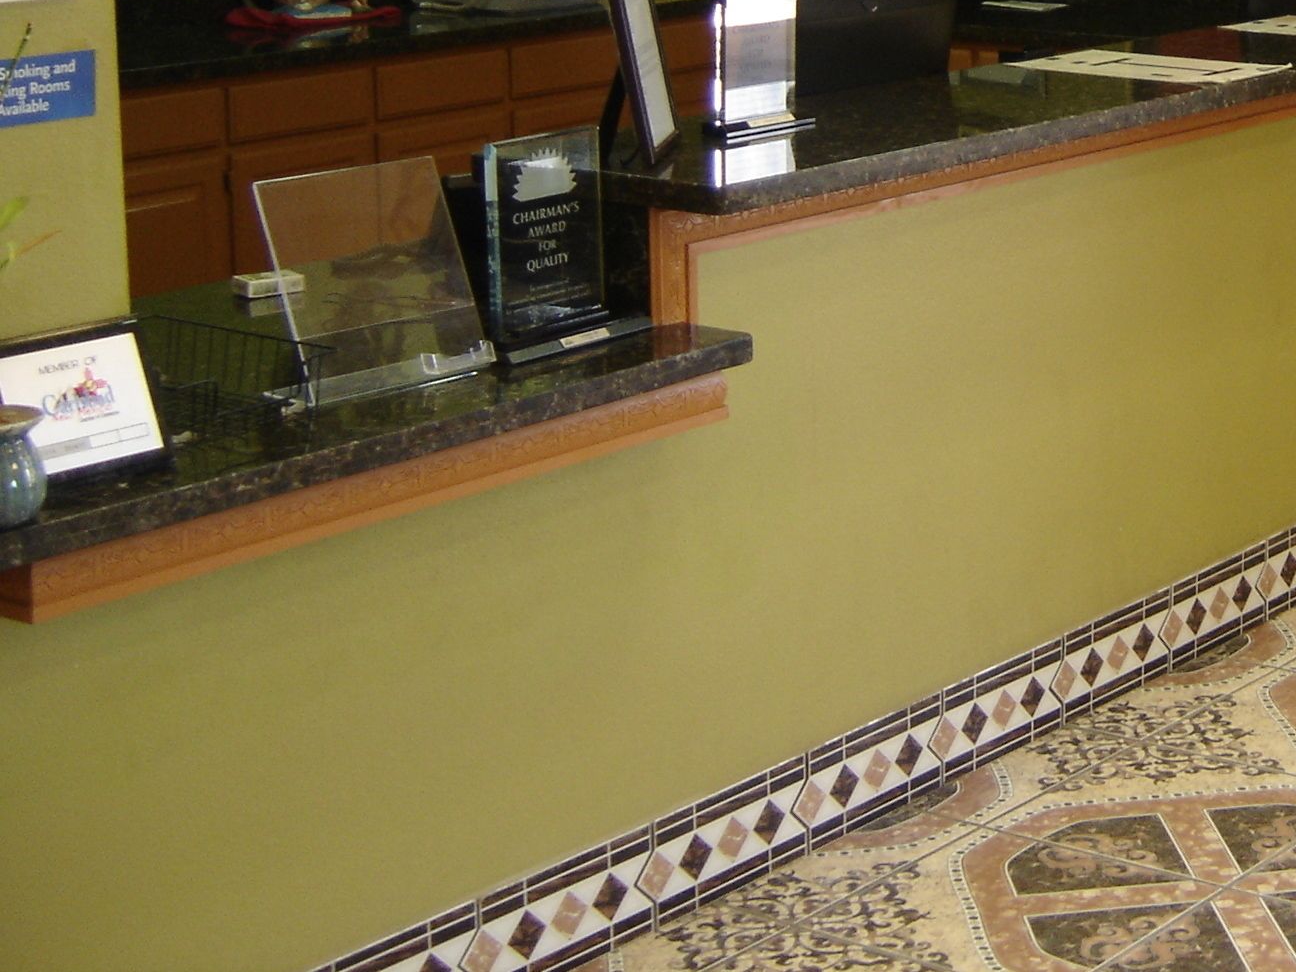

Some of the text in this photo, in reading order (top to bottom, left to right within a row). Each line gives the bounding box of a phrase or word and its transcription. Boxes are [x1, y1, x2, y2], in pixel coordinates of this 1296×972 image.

[53, 59, 76, 73] and
[30, 81, 70, 94] Rooms
[0, 98, 50, 116] Available
[512, 201, 579, 224] CHAIRMAN'S
[528, 221, 566, 237] AWARD
[538, 239, 557, 252] FOR
[527, 253, 569, 272] QUALITY
[39, 356, 96, 374] MEMBER OF
